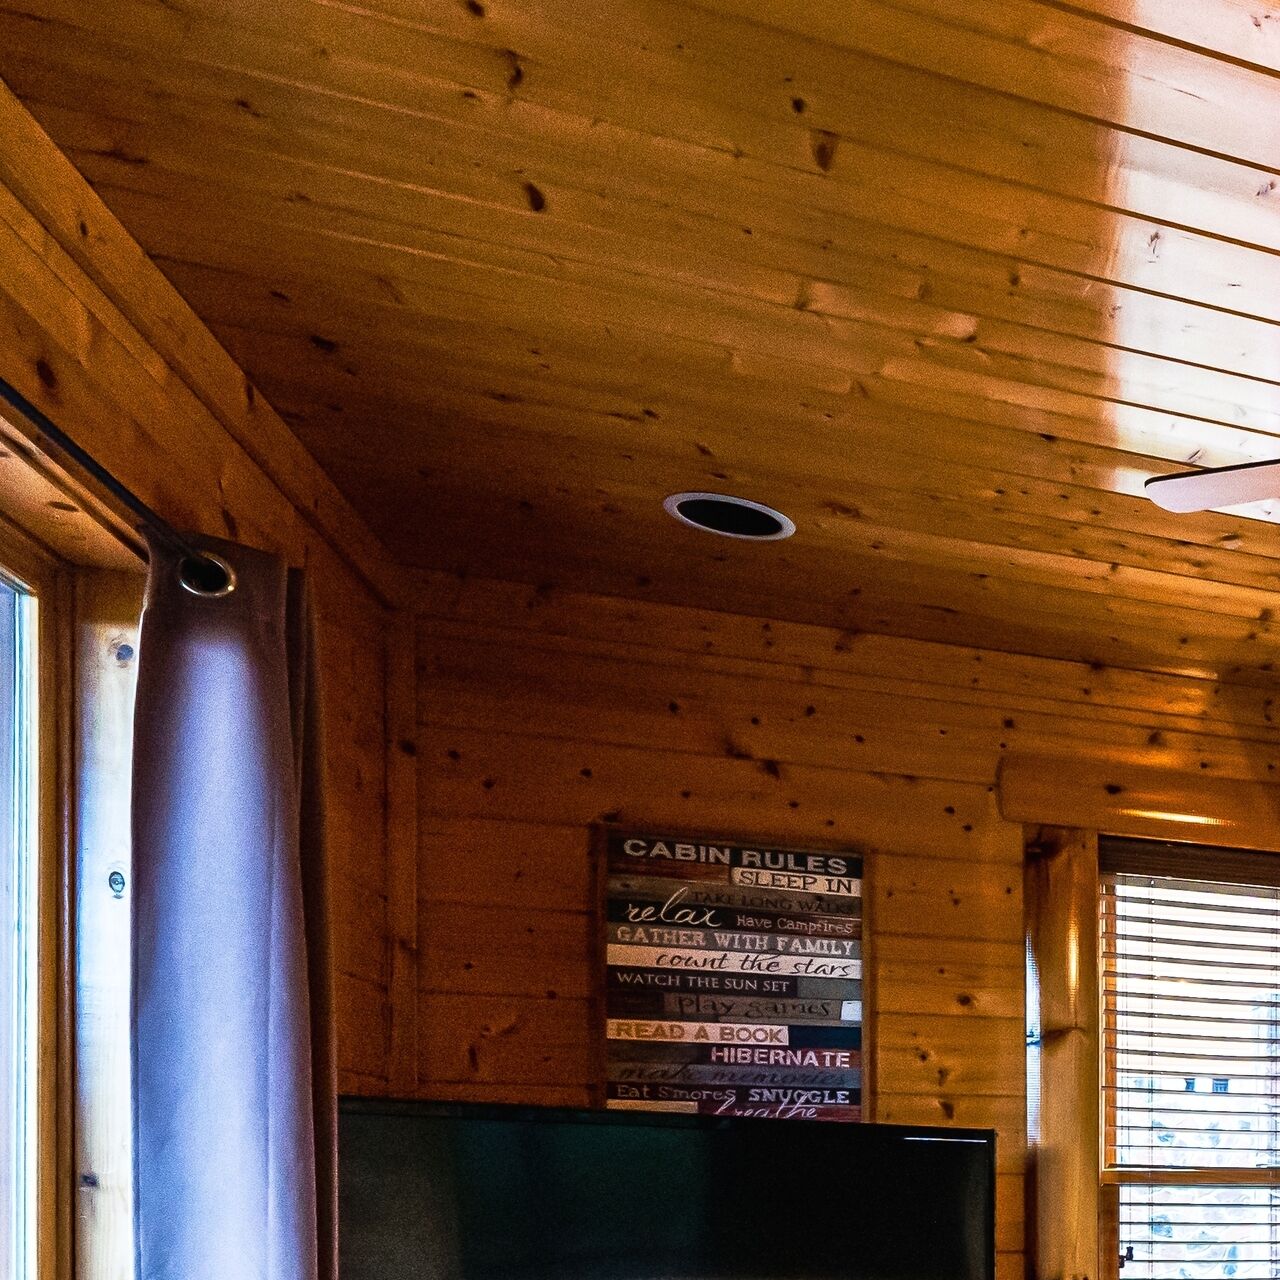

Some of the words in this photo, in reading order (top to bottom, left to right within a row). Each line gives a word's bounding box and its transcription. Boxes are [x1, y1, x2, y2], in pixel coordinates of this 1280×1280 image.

[624, 839, 731, 865] CABIN
[742, 850, 847, 875] RULES
[739, 871, 818, 891] SLEEP
[825, 878, 853, 894] IN
[624, 886, 723, 928] relax
[691, 891, 737, 907] TAKE
[741, 894, 793, 911] LONG
[798, 901, 856, 917] WALKS
[737, 915, 772, 929] Have
[777, 918, 854, 935] Campfires
[617, 926, 706, 946] GATHER
[714, 932, 769, 951] WITH
[776, 937, 854, 956] FAMILY
[655, 953, 731, 970] count
[739, 950, 782, 973] the
[789, 959, 854, 977] stars
[617, 972, 680, 986] WATCH
[688, 976, 719, 988] THE
[724, 978, 758, 991] SUN
[763, 981, 790, 992] SET
[677, 996, 735, 1017] play
[744, 1002, 832, 1019] games
[615, 1022, 685, 1040] READ
[694, 1025, 710, 1042] A
[719, 1026, 784, 1043] BOOK
[711, 1047, 850, 1068] HIBERNATE
[617, 1085, 650, 1099] Eat
[748, 1088, 850, 1104] SNUGGLE
